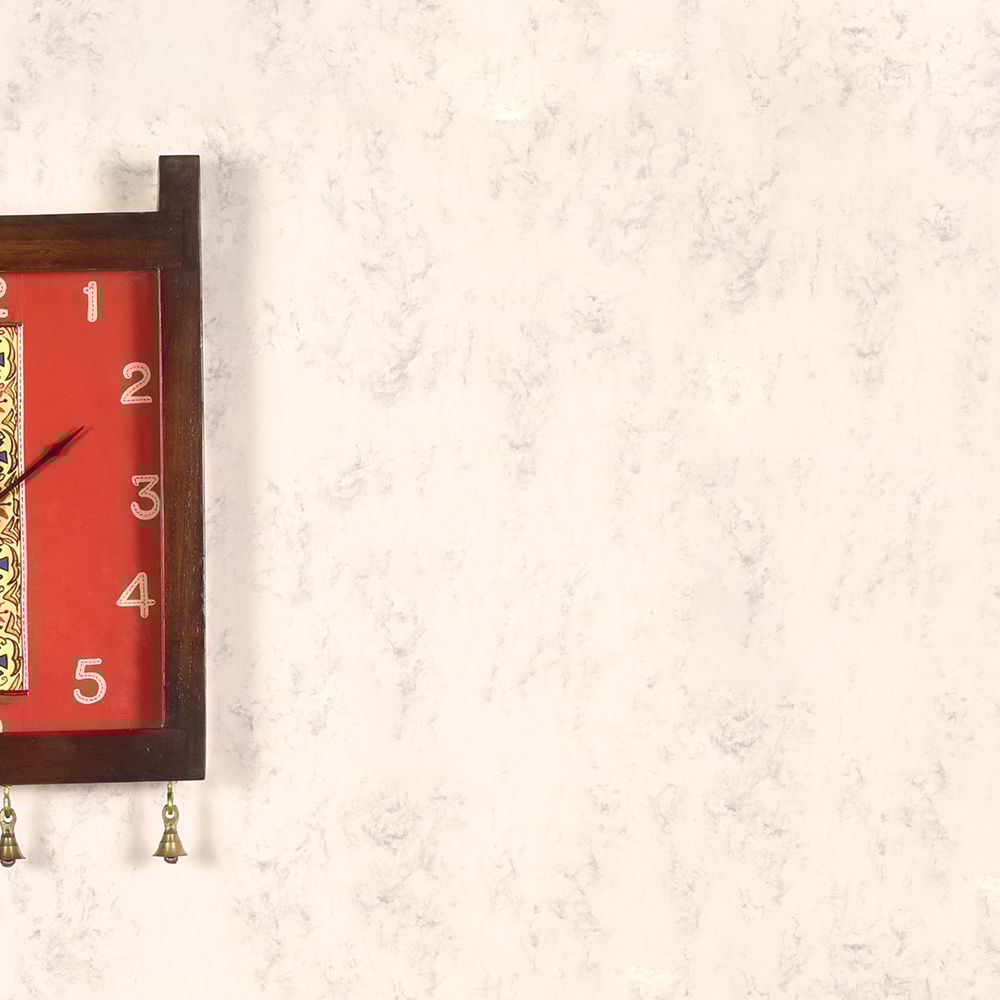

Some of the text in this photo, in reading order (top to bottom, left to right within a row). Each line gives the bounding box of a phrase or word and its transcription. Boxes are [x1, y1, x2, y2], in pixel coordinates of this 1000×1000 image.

[82, 281, 98, 323] 1
[120, 363, 152, 405] 2
[131, 474, 161, 521] 3
[116, 572, 155, 619] 4
[74, 657, 107, 705] 5
